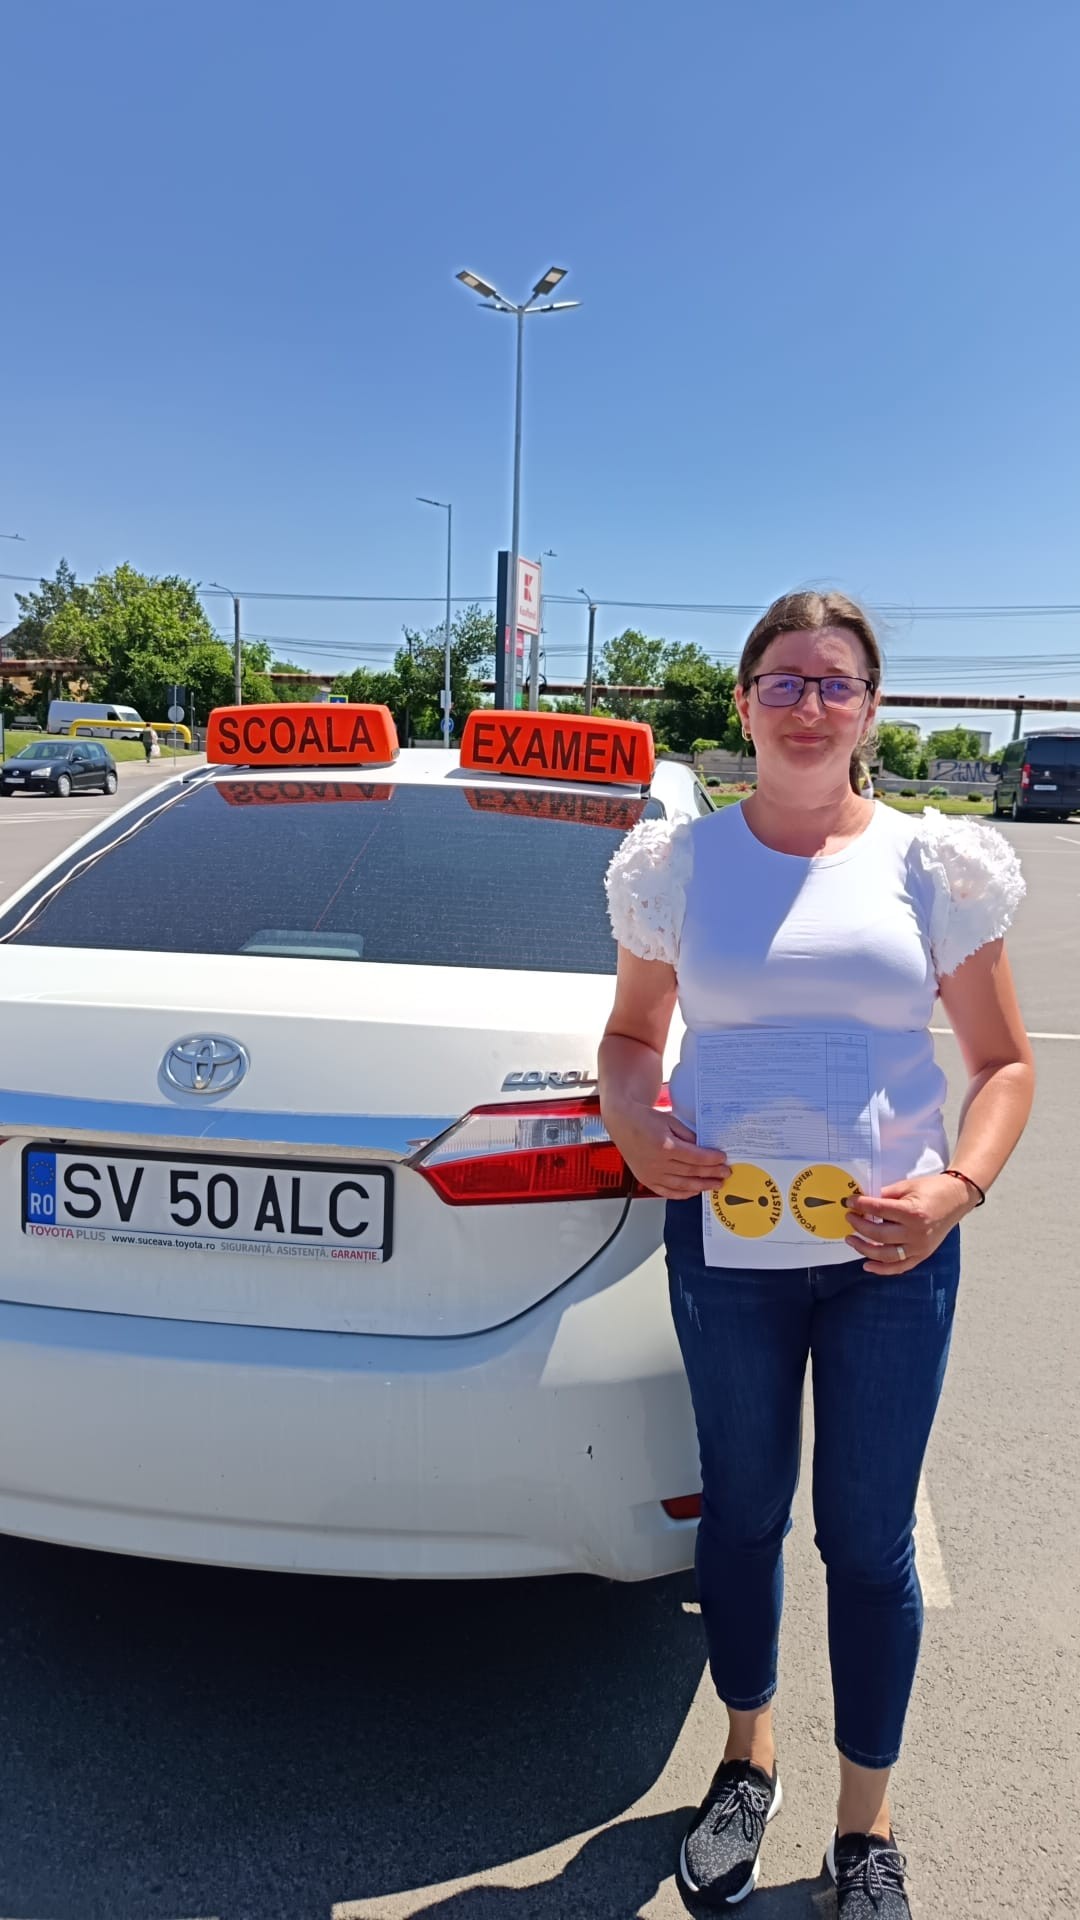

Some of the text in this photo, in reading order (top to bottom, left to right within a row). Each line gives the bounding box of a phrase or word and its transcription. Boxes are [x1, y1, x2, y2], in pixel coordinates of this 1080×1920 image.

[219, 715, 375, 754] SCOALA
[473, 723, 636, 776] EXAMEN
[502, 1070, 598, 1087] COROL
[30, 1192, 54, 1216] RO
[64, 1163, 370, 1238] SV 50 ALC
[764, 1178, 781, 1225] ALISTAR
[791, 1192, 798, 1202] DE
[29, 1224, 74, 1239] TOYOTA
[76, 1229, 106, 1241] PLUS
[112, 1234, 216, 1250] www.suceava.toyota.ro
